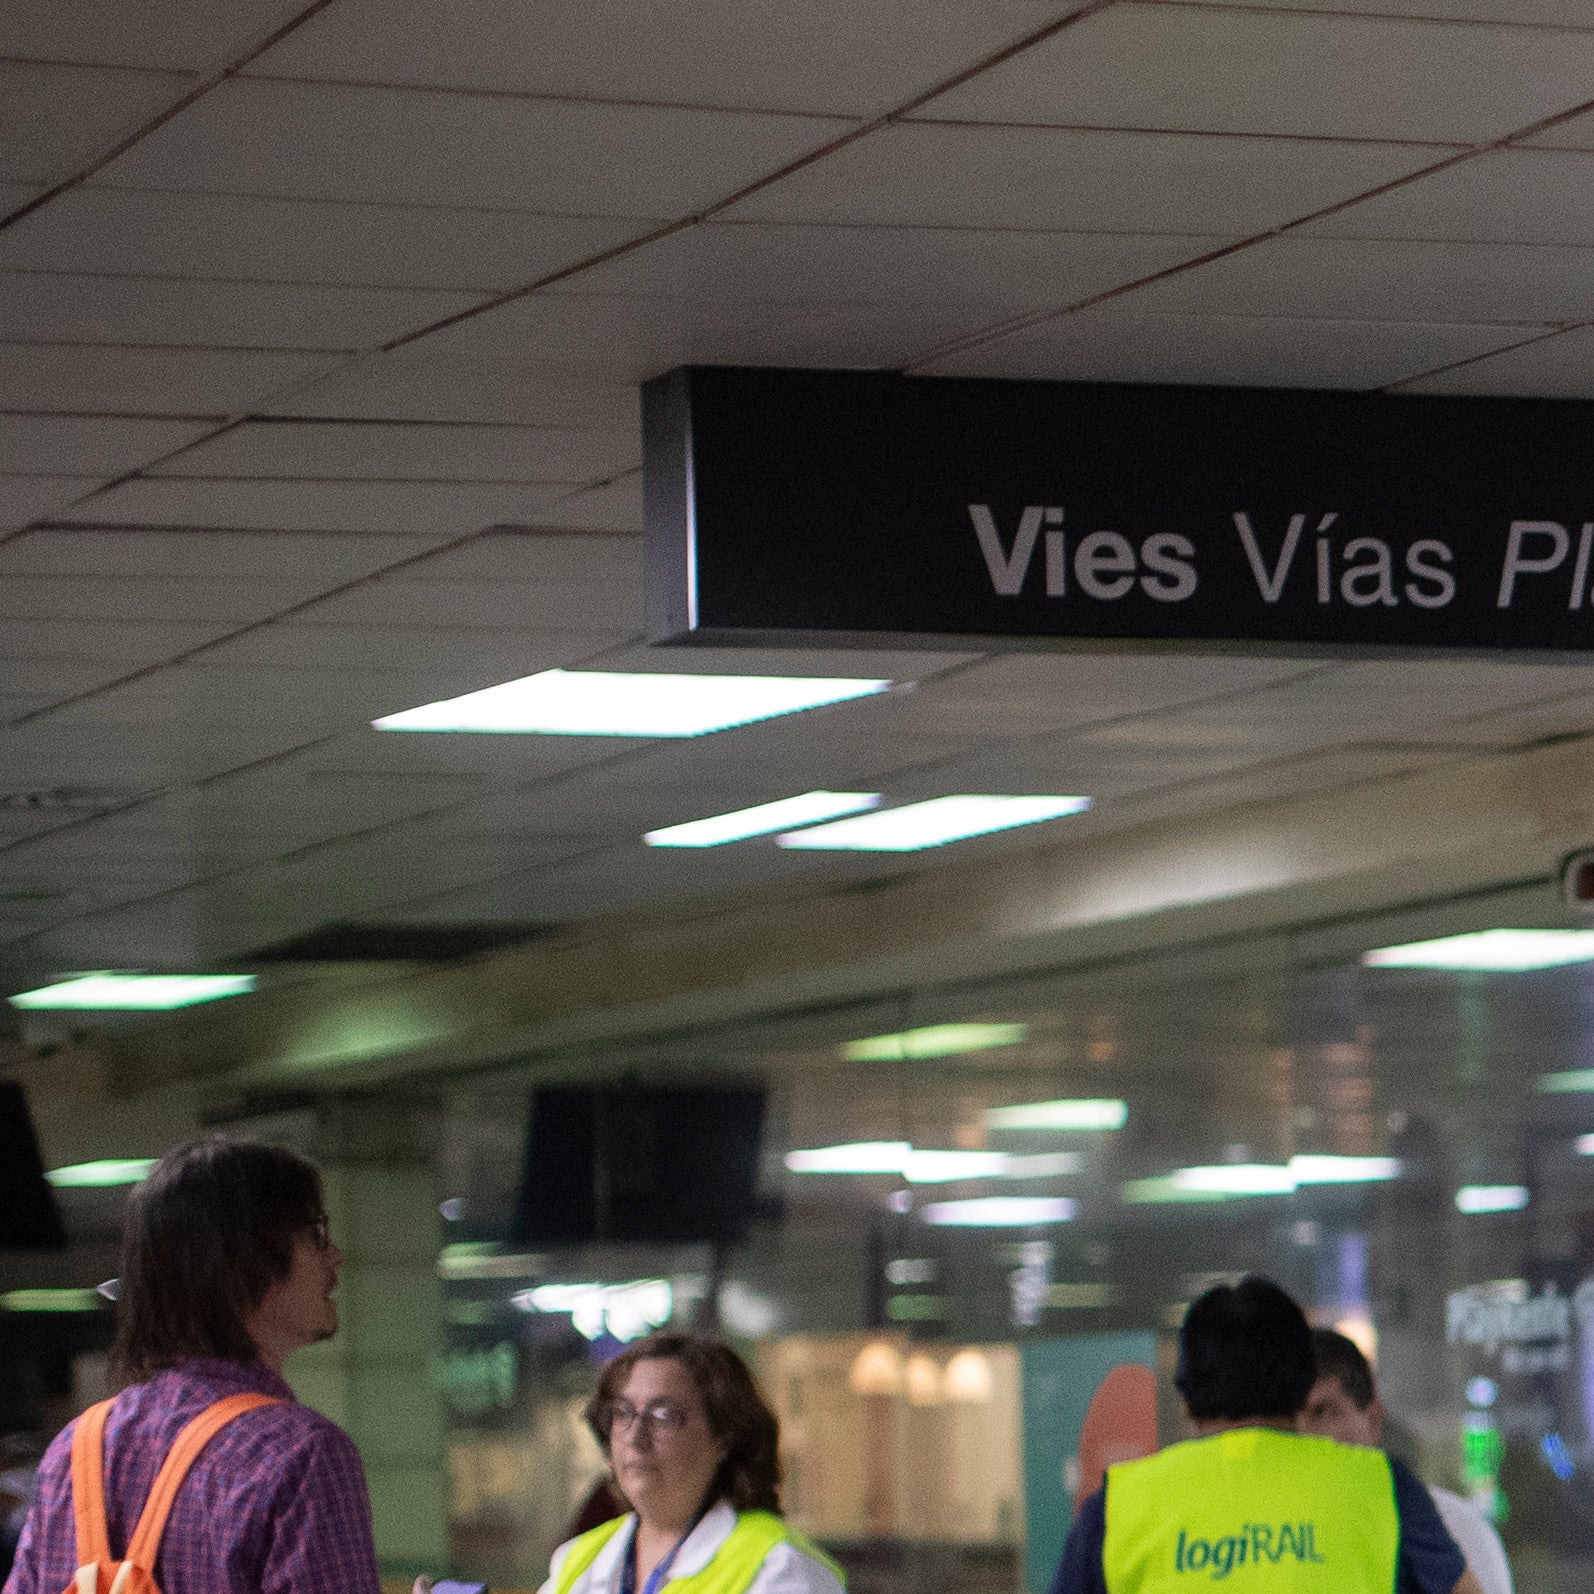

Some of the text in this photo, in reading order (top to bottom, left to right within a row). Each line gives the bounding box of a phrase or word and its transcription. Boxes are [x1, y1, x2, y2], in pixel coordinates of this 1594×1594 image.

[967, 503, 1197, 601] Vies
[1231, 511, 1457, 608] Vías
[1174, 1521, 1326, 1582] logiRAIL
